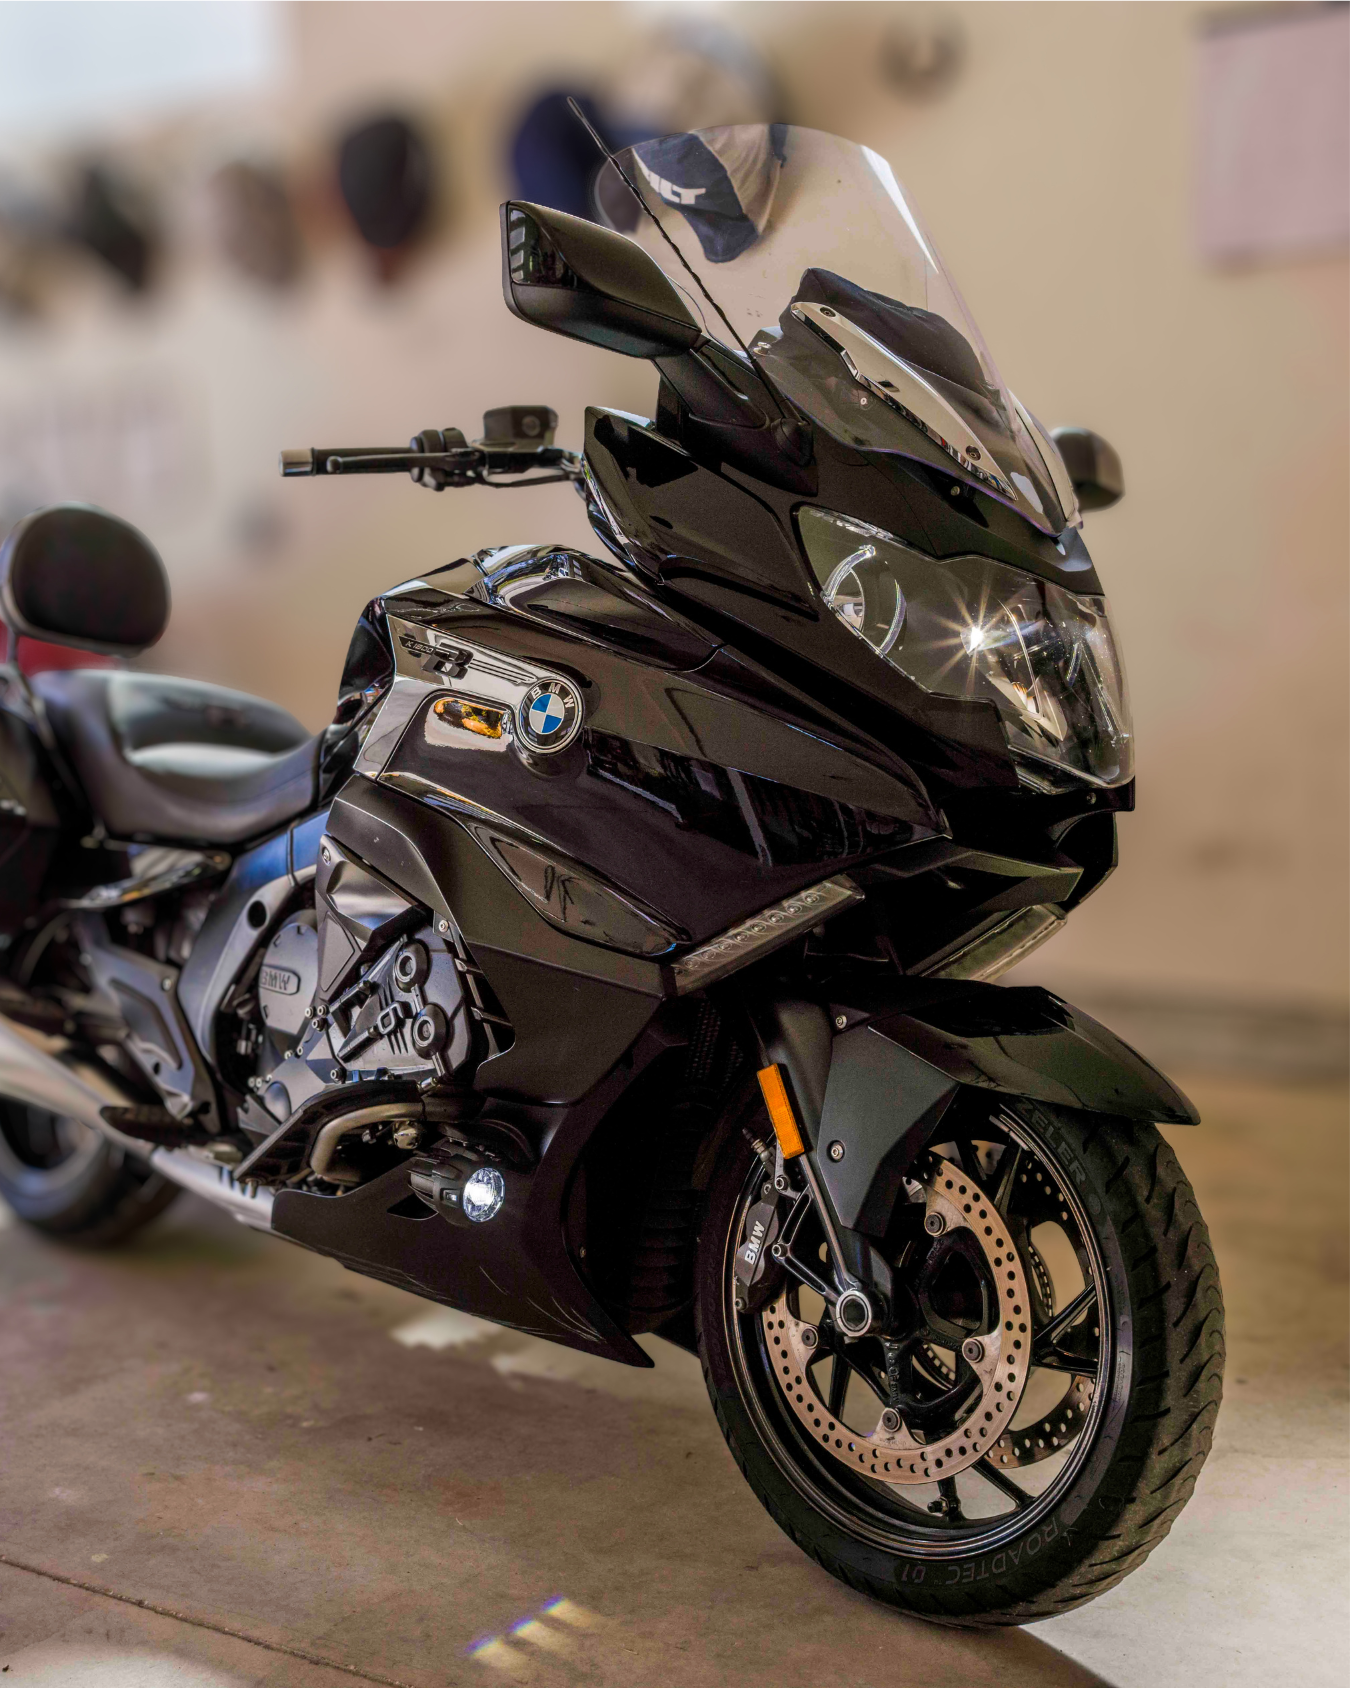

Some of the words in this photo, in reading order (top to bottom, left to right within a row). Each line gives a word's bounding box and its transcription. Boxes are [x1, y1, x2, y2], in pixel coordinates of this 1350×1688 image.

[530, 682, 576, 709] BMW
[261, 968, 291, 991] BMW
[1015, 1098, 1086, 1185] ZELER
[744, 1220, 766, 1266] BMW
[946, 1517, 1059, 1585] ROADTEC
[901, 1563, 927, 1584] 01
